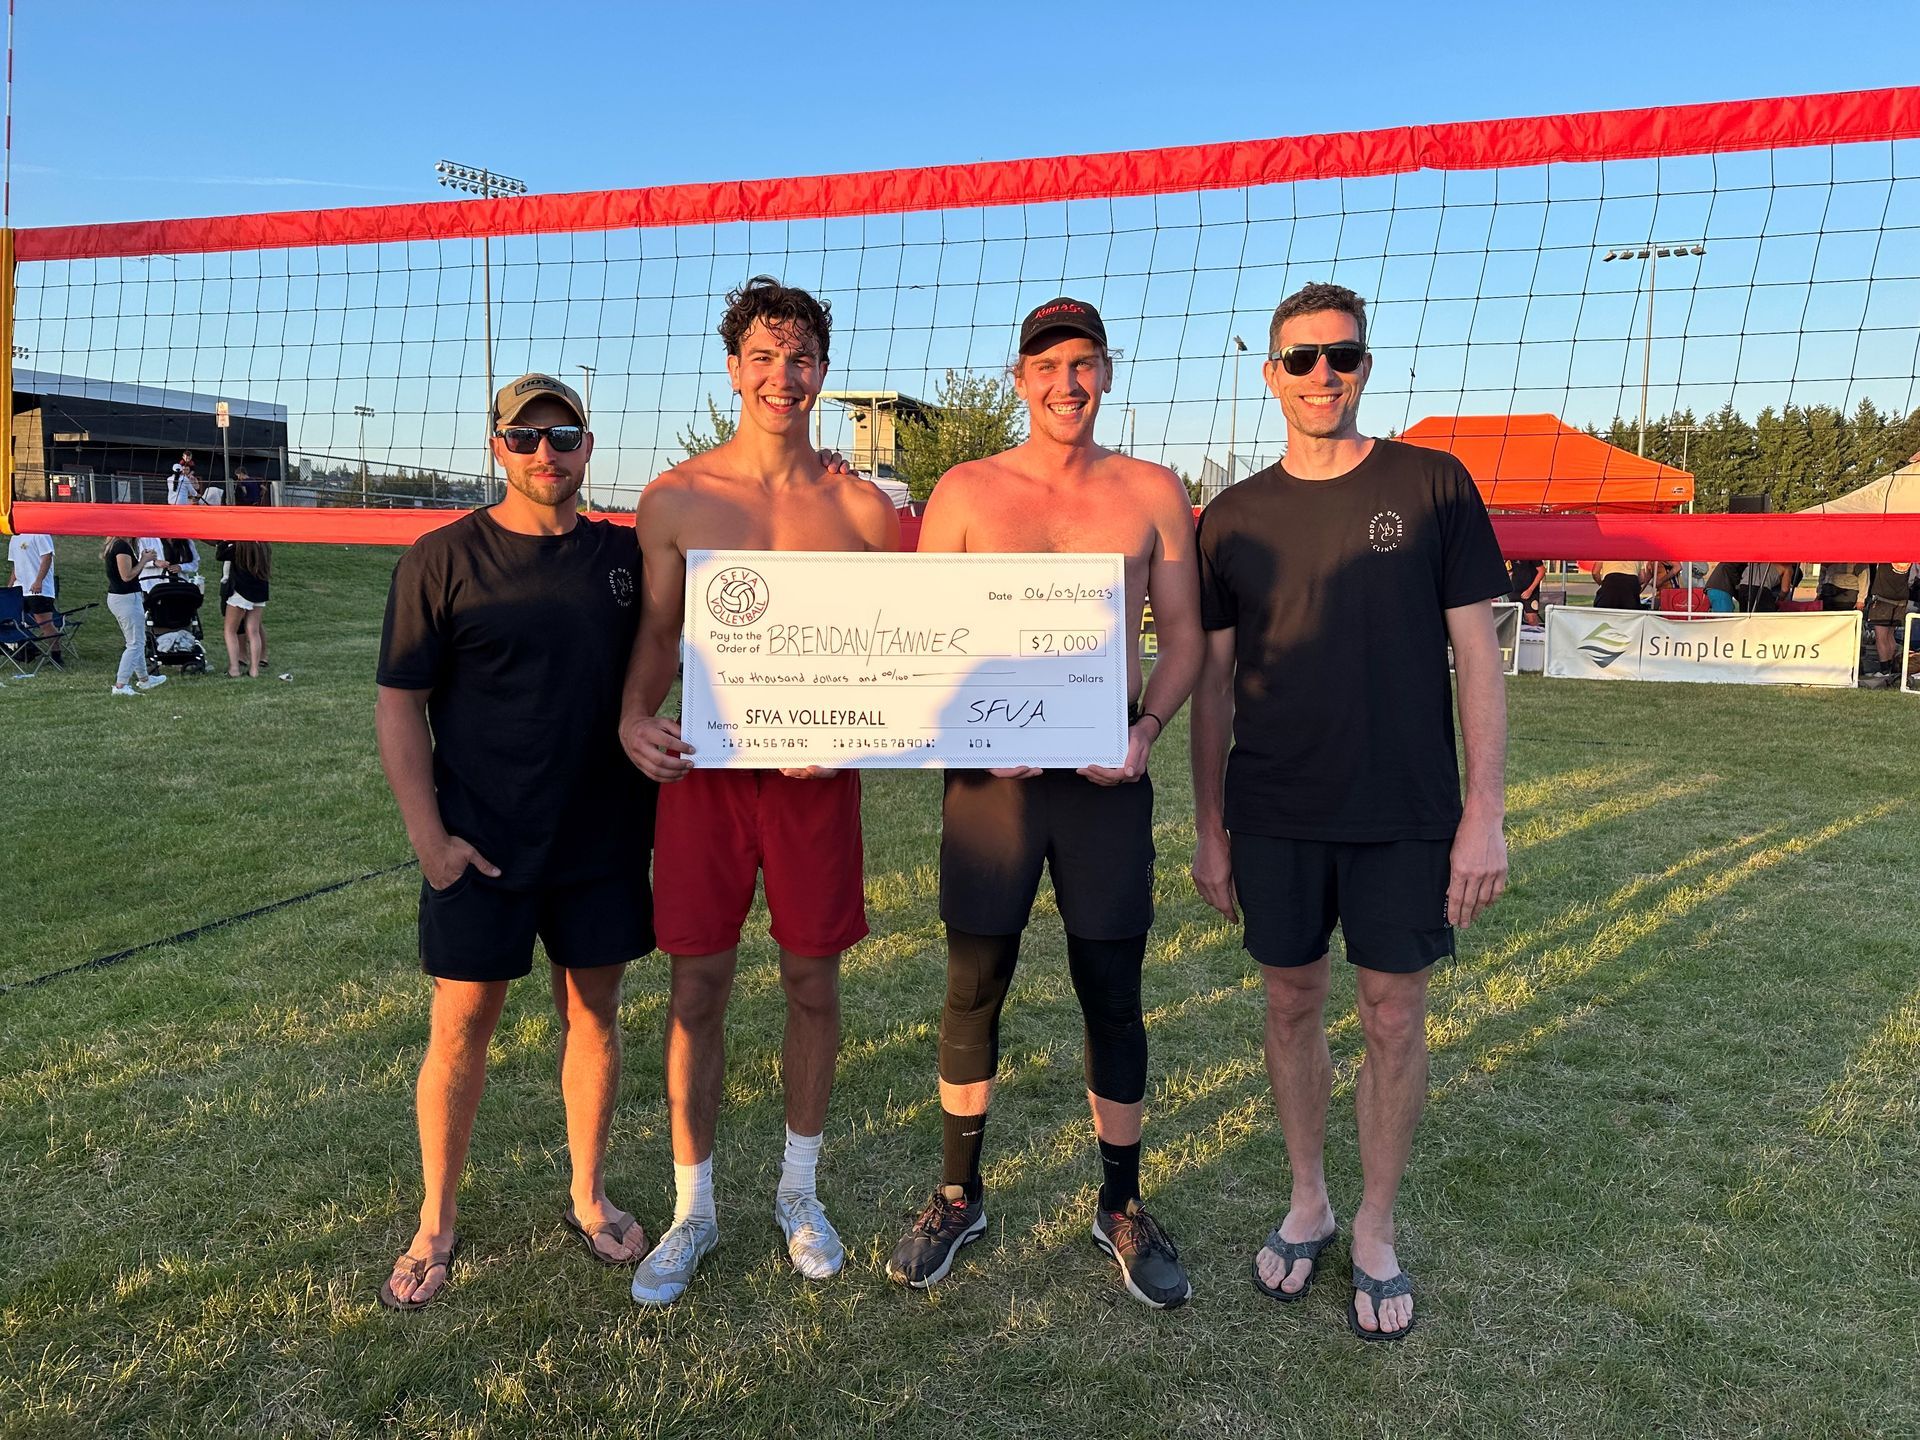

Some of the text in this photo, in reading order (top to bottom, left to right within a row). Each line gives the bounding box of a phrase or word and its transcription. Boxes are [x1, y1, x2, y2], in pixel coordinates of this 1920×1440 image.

[720, 571, 757, 588] SFVA
[988, 591, 1013, 601] Date
[1024, 583, 1113, 604] 06/03/2023
[710, 597, 766, 624] VOLLEYBALL
[710, 630, 762, 642] Pay to the
[716, 643, 760, 653] Order of
[1032, 633, 1099, 656] $2,000
[717, 670, 745, 684] Two
[749, 671, 805, 684] thousand
[813, 673, 849, 684] dollars
[858, 674, 877, 682] and
[1068, 673, 1104, 683] Dollars
[745, 708, 886, 726] SFVA VOLLEYBALL
[967, 699, 1046, 728] SFVA
[707, 720, 739, 730] Memo
